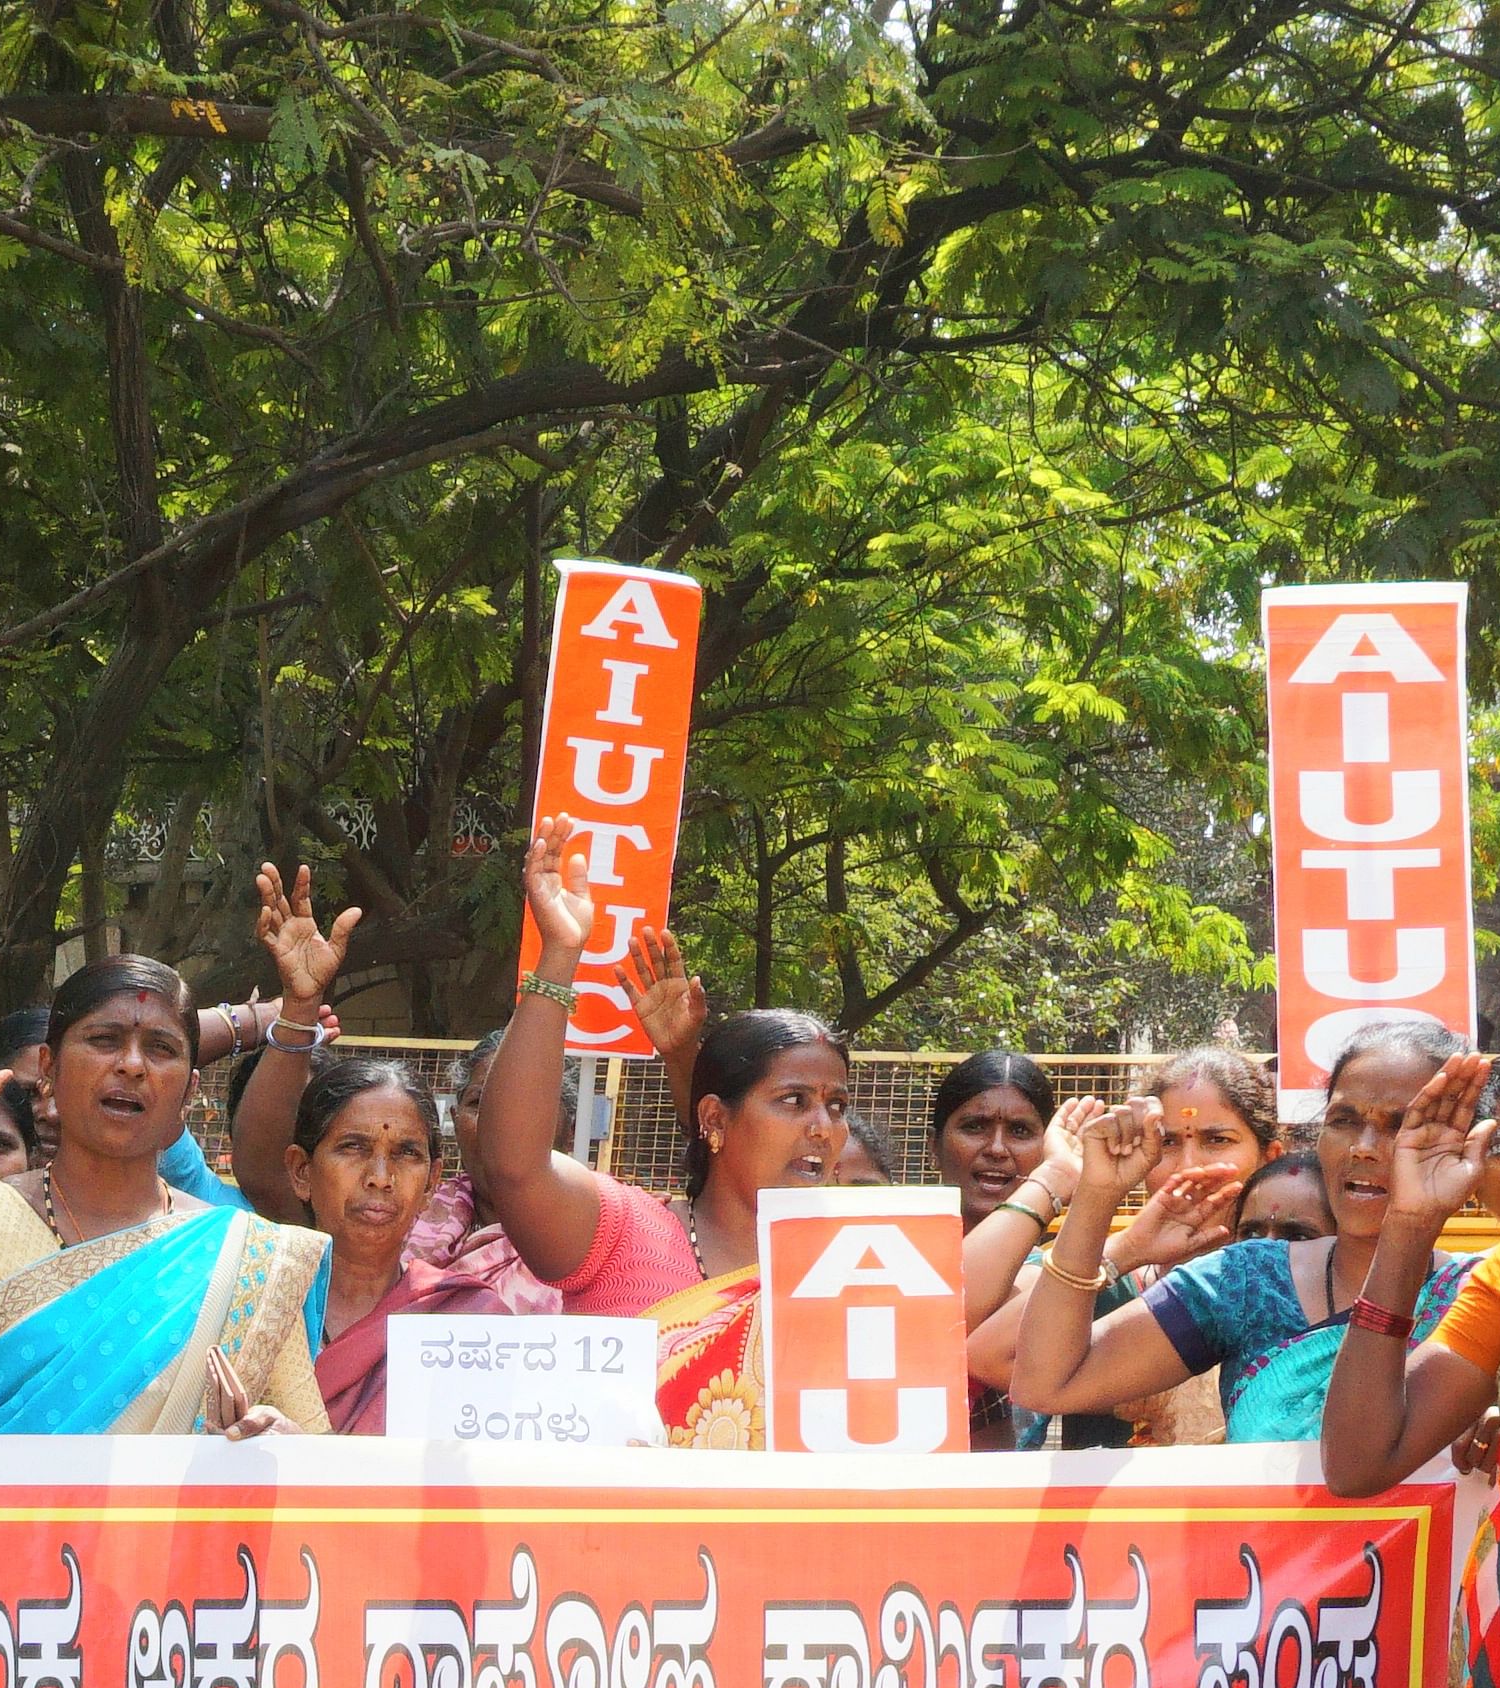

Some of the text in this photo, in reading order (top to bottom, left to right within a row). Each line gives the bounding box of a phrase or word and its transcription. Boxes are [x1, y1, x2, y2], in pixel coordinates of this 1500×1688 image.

[419, 1330, 625, 1374] ವರ್ಷದ 12
[790, 1224, 955, 1452] AIU
[453, 1401, 590, 1443] ತಿಂಗಳು
